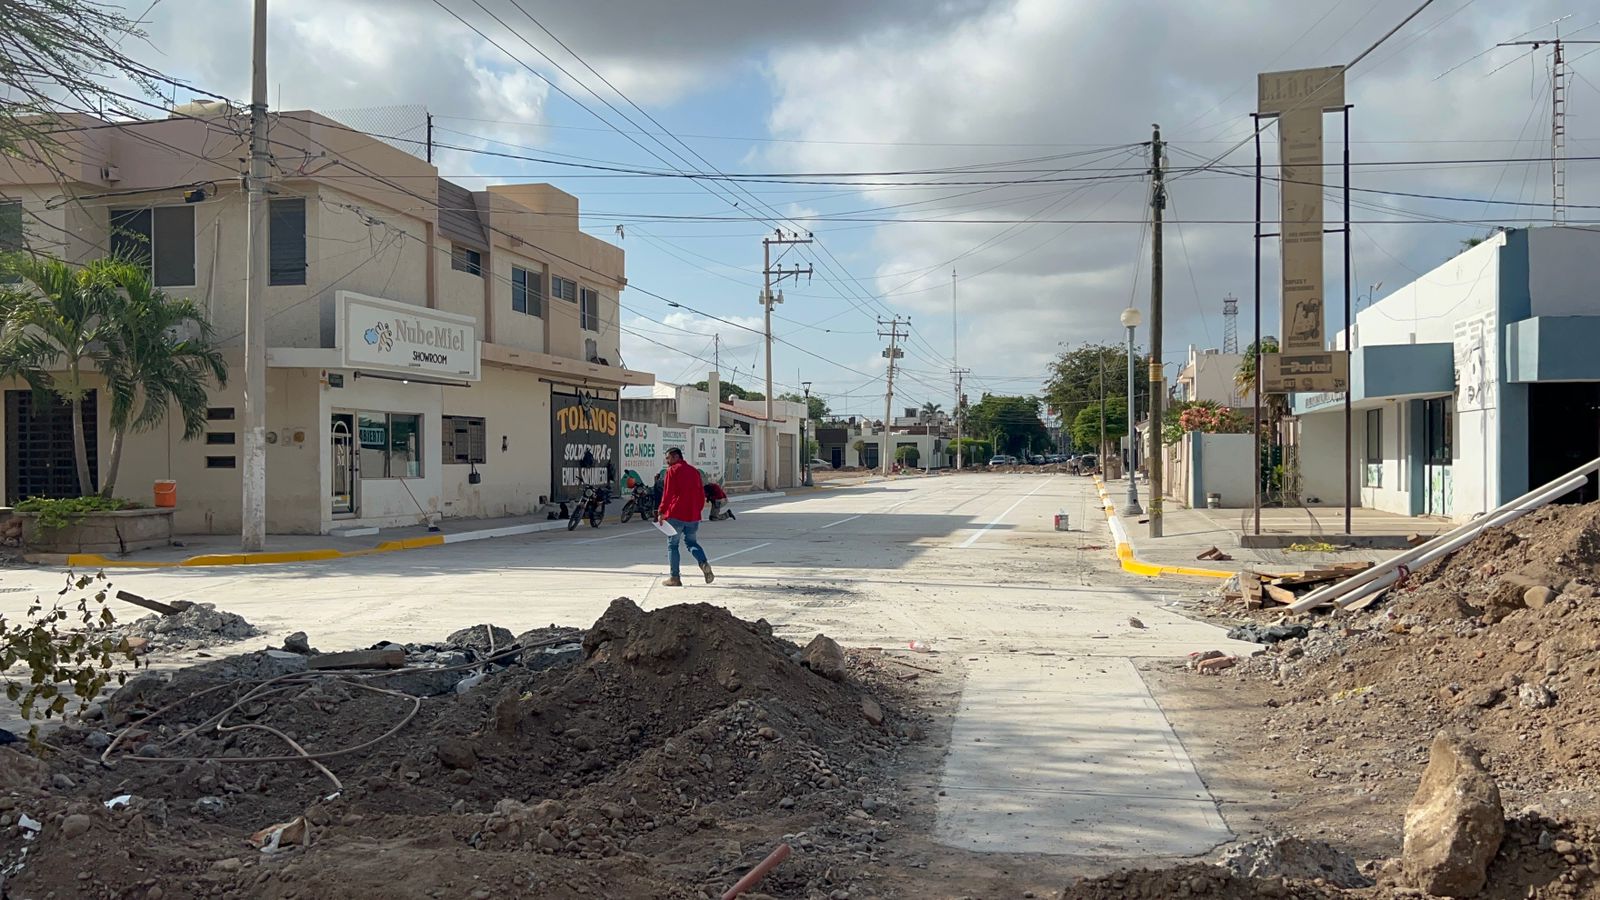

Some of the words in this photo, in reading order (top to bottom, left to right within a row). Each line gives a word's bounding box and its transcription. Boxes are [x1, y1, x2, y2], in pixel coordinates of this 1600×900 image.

[395, 319, 465, 352] NubeMiel
[412, 351, 448, 365] SHOWROOM
[1290, 361, 1332, 373] Parker
[624, 423, 647, 439] CASAS
[564, 443, 612, 464] SOLDURAS
[624, 443, 655, 458] GRANDES
